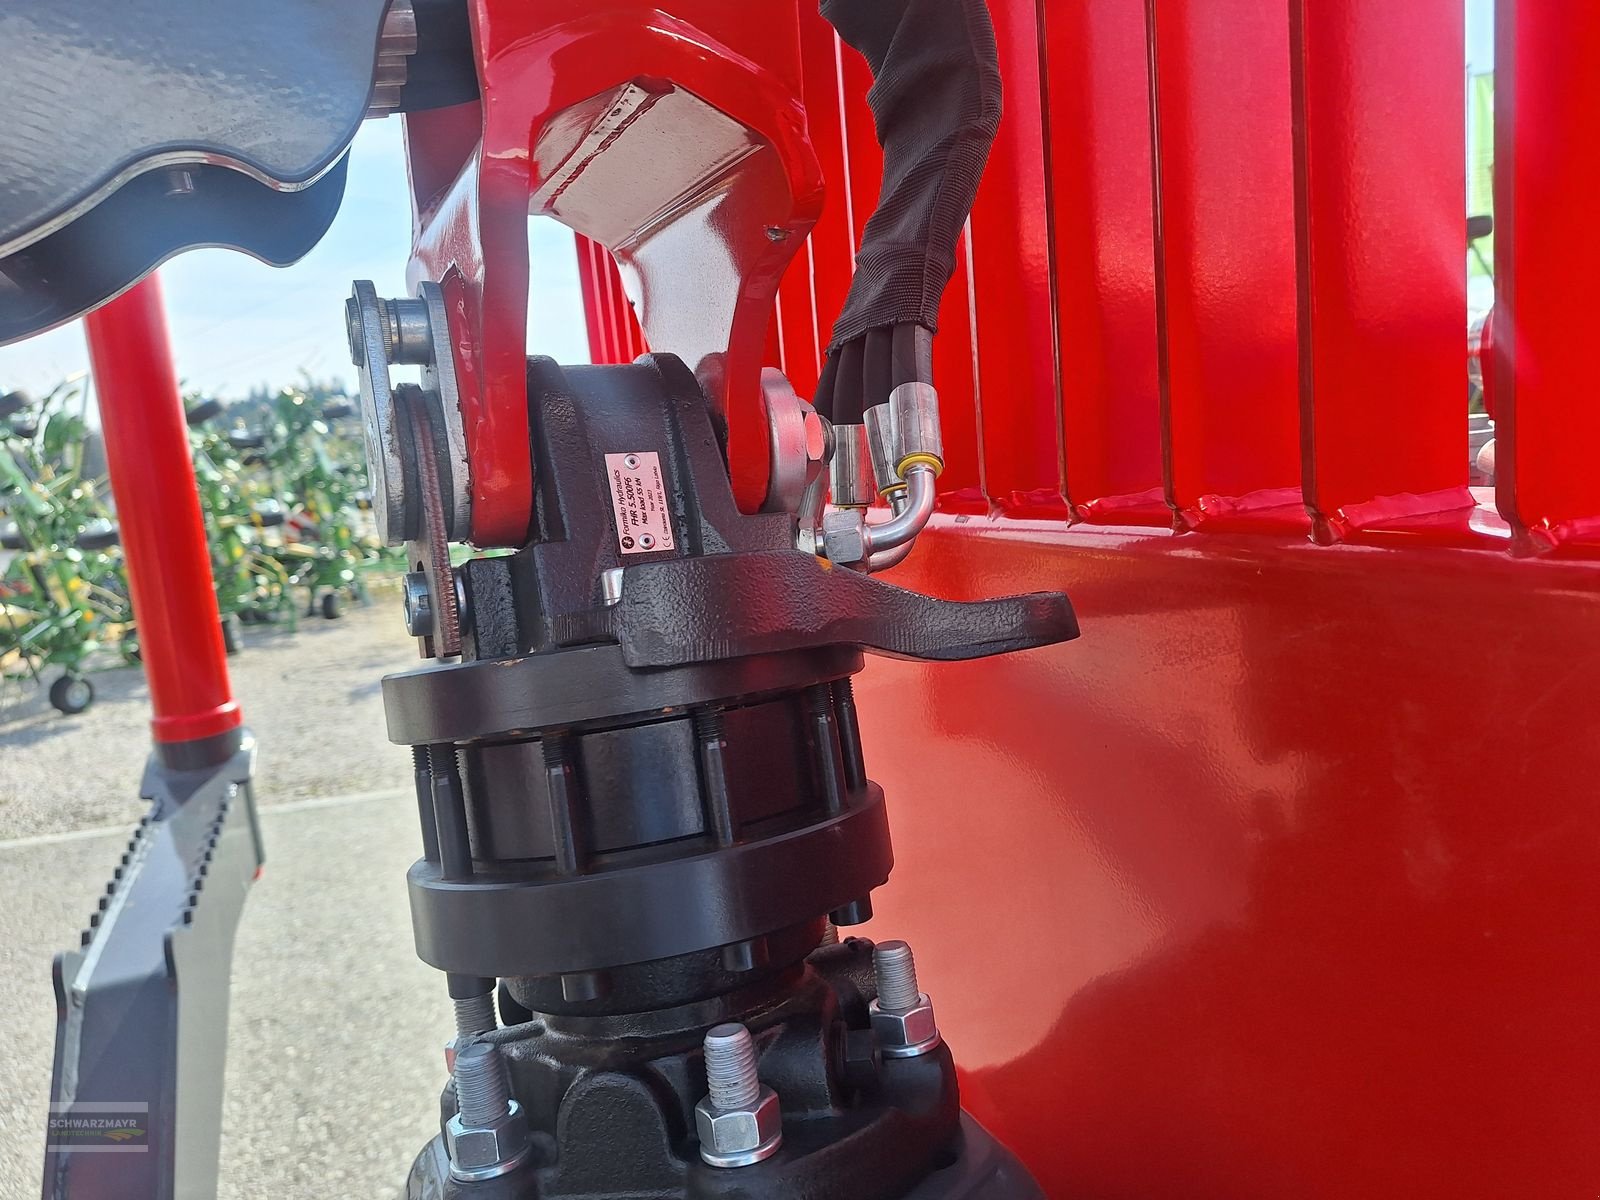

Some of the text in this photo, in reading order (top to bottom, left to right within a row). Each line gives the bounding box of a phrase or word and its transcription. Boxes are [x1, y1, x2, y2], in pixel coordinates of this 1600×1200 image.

[634, 478, 642, 486] kN
[637, 487, 643, 496] 55
[614, 469, 630, 535] Formiko Hydraulics
[624, 477, 639, 526] FHR 5.500F6
[638, 496, 646, 510] load
